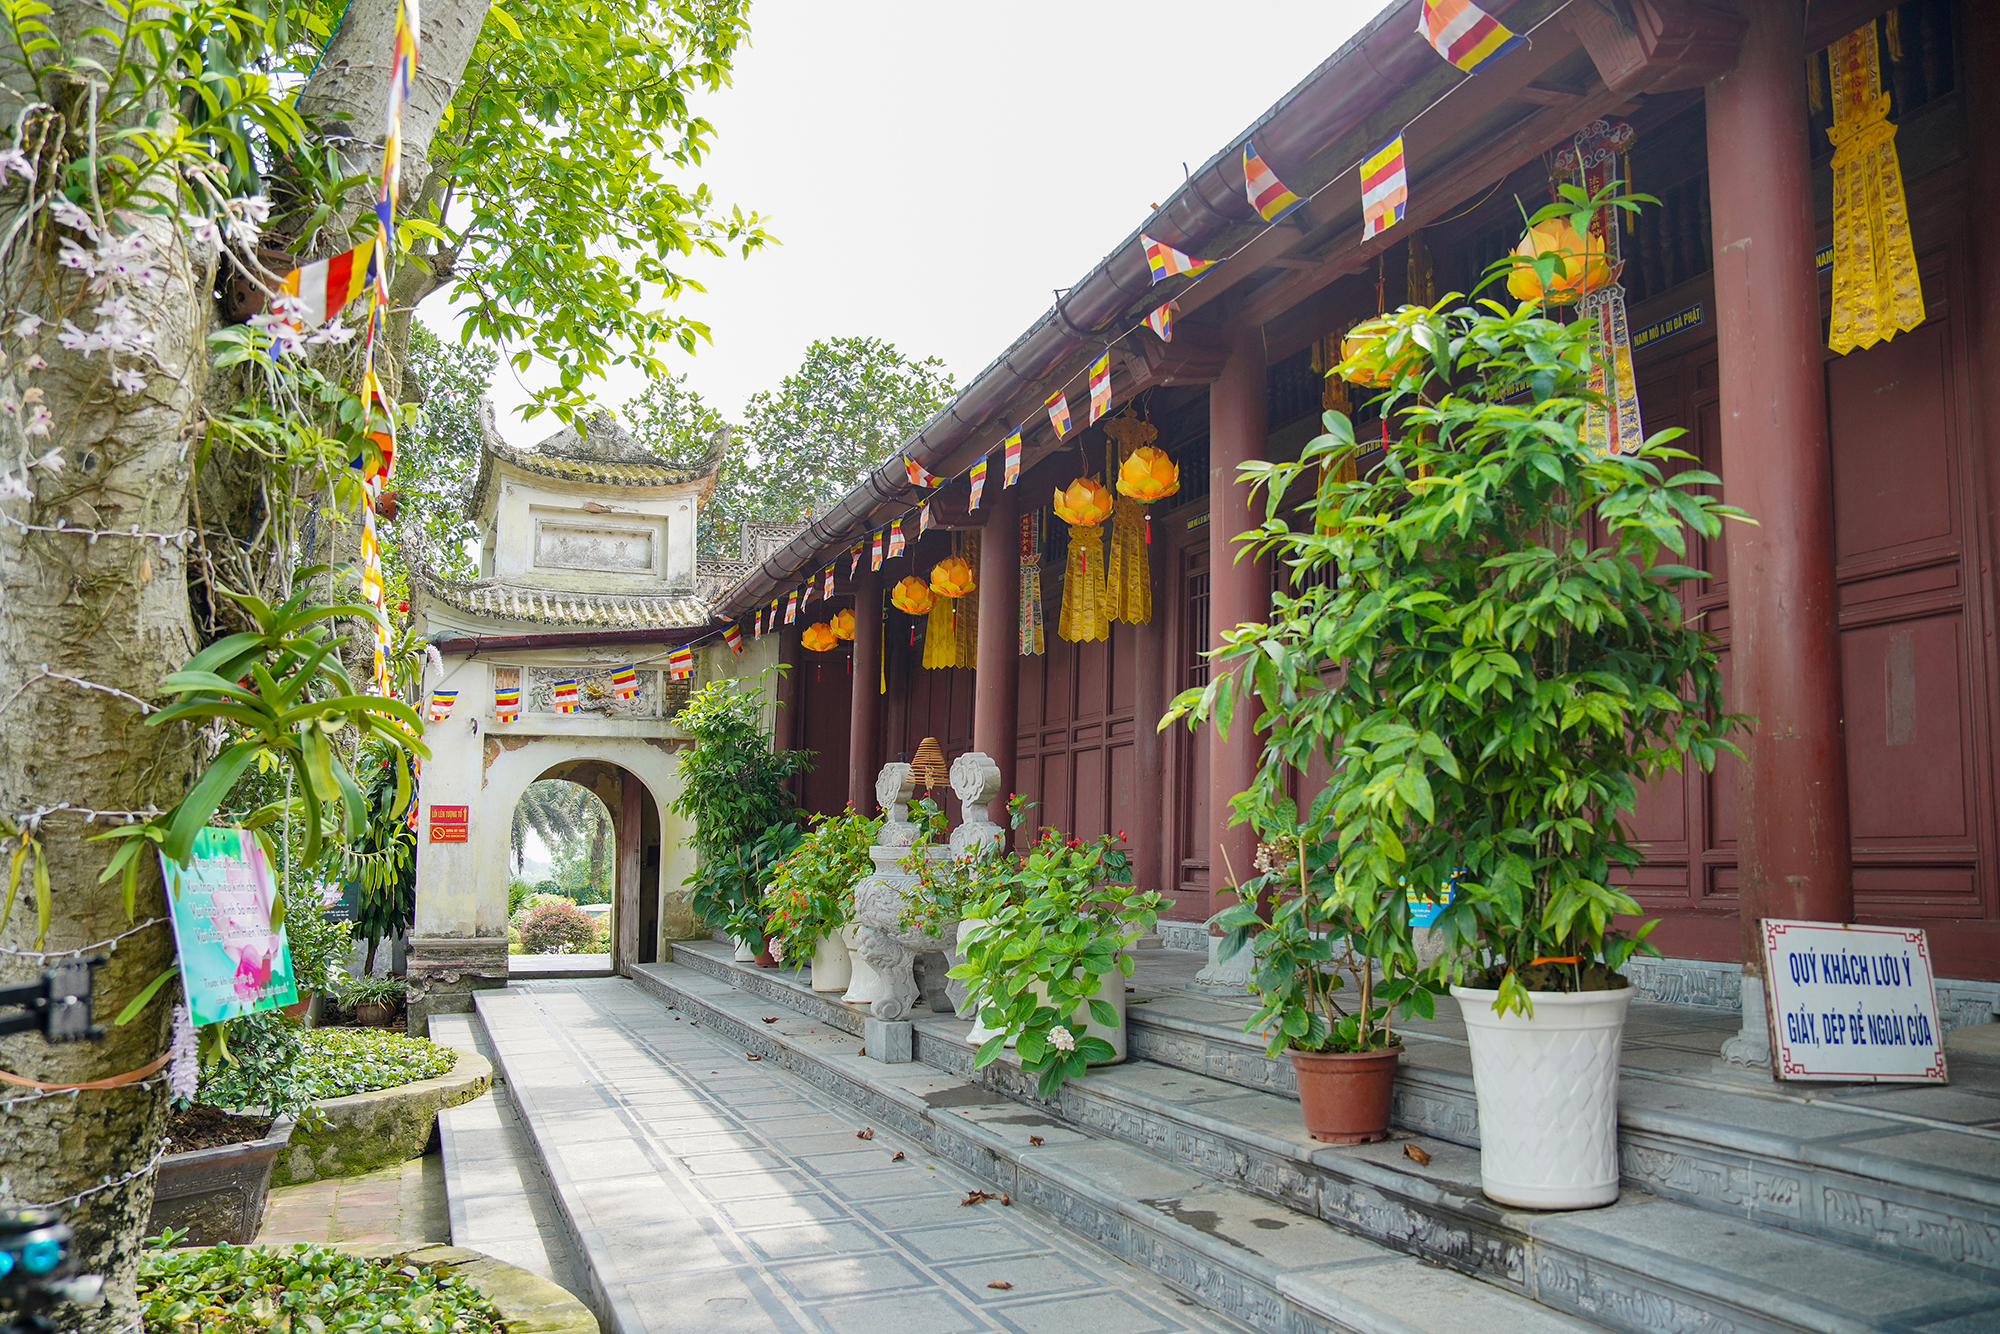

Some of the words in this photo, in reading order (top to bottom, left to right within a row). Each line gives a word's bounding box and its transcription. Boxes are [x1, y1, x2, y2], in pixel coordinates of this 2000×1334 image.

[1816, 249, 1834, 268] NAM
[1634, 331, 1648, 347] NAM
[1649, 324, 1660, 340] MÔ
[1661, 324, 1666, 336] A
[1666, 320, 1674, 333] DI
[1674, 314, 1684, 330] ĐÀ
[1684, 307, 1700, 325] PHẬT
[184, 878, 199, 894] Vui
[189, 902, 204, 919] Vui
[194, 927, 209, 945] Vui
[1789, 947, 1817, 987] QUÝ
[1821, 948, 1871, 985] KHÁCH
[1871, 953, 1900, 987] LƯU
[1901, 950, 1912, 987] Ý
[1822, 1007, 1846, 1045] DÉP
[1848, 1000, 1867, 1045] ĐỂ
[1867, 1008, 1907, 1046] NGOÀI
[1906, 1003, 1934, 1047] CỬA
